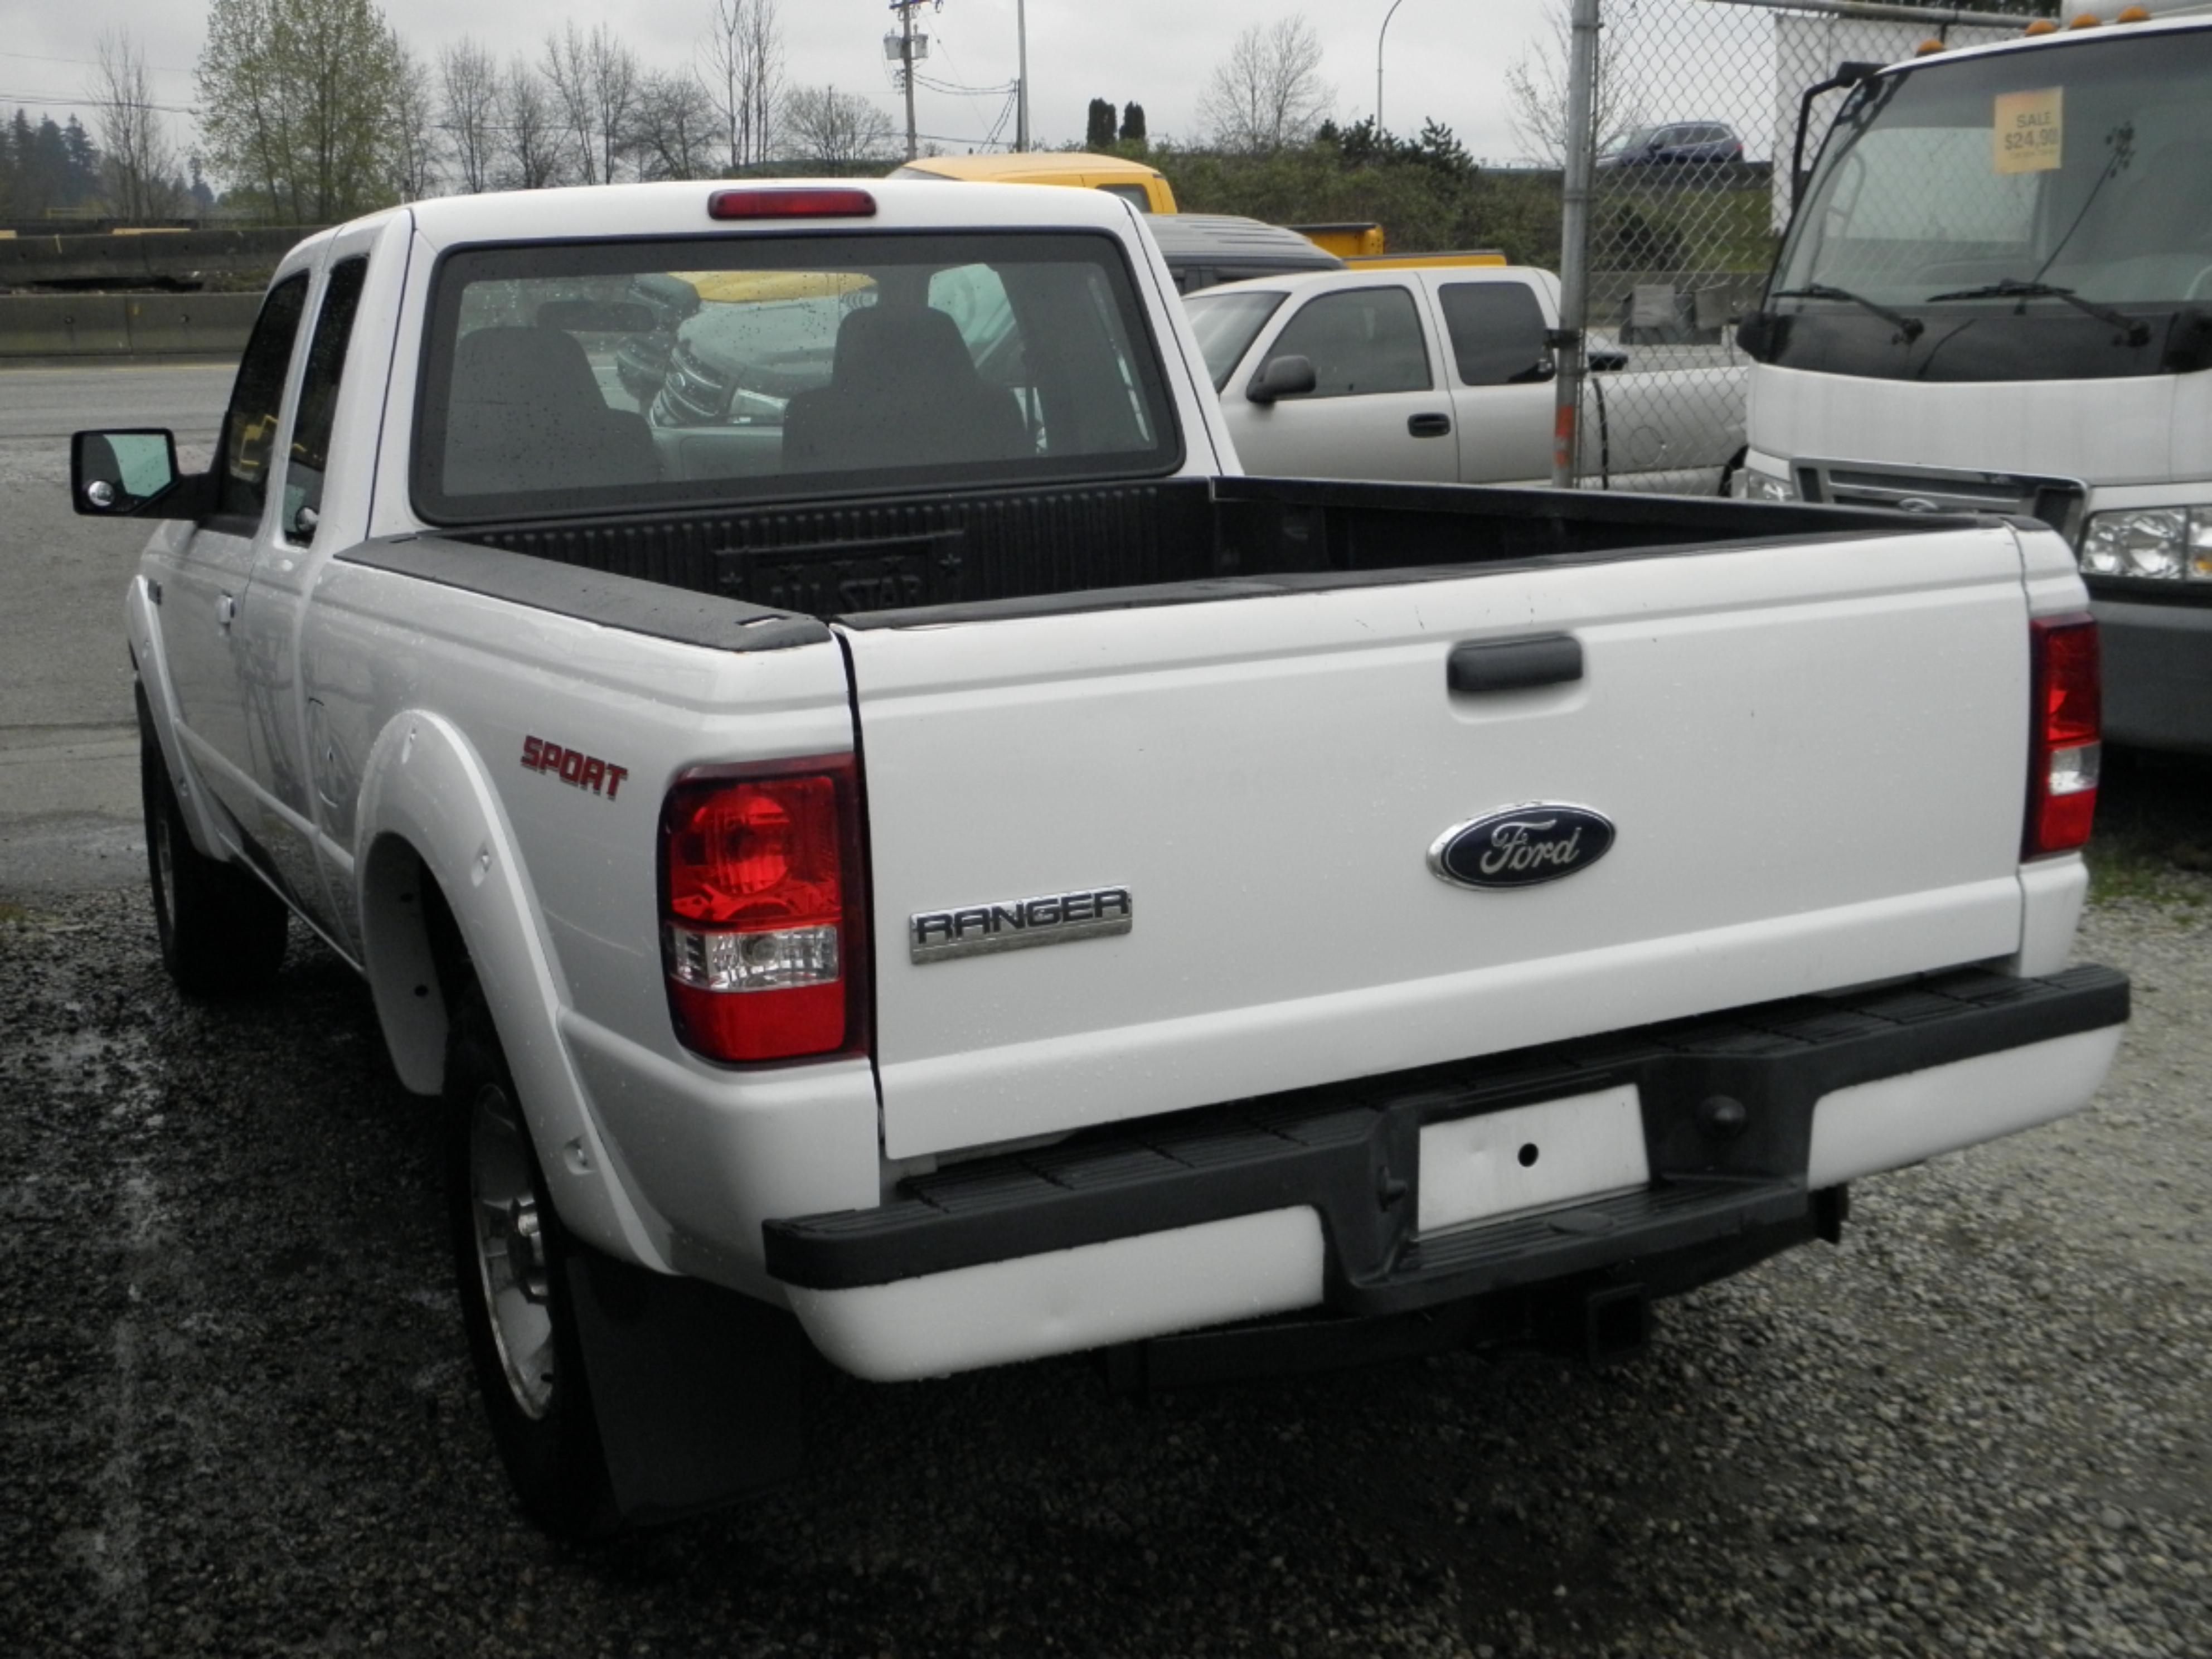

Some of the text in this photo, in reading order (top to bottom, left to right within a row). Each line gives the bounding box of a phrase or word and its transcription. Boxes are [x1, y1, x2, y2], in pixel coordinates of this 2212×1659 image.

[2016, 111, 2052, 128] SALE
[520, 735, 629, 802] SPORT
[1480, 818, 1582, 874] Ford
[916, 889, 1130, 944] RANGER
